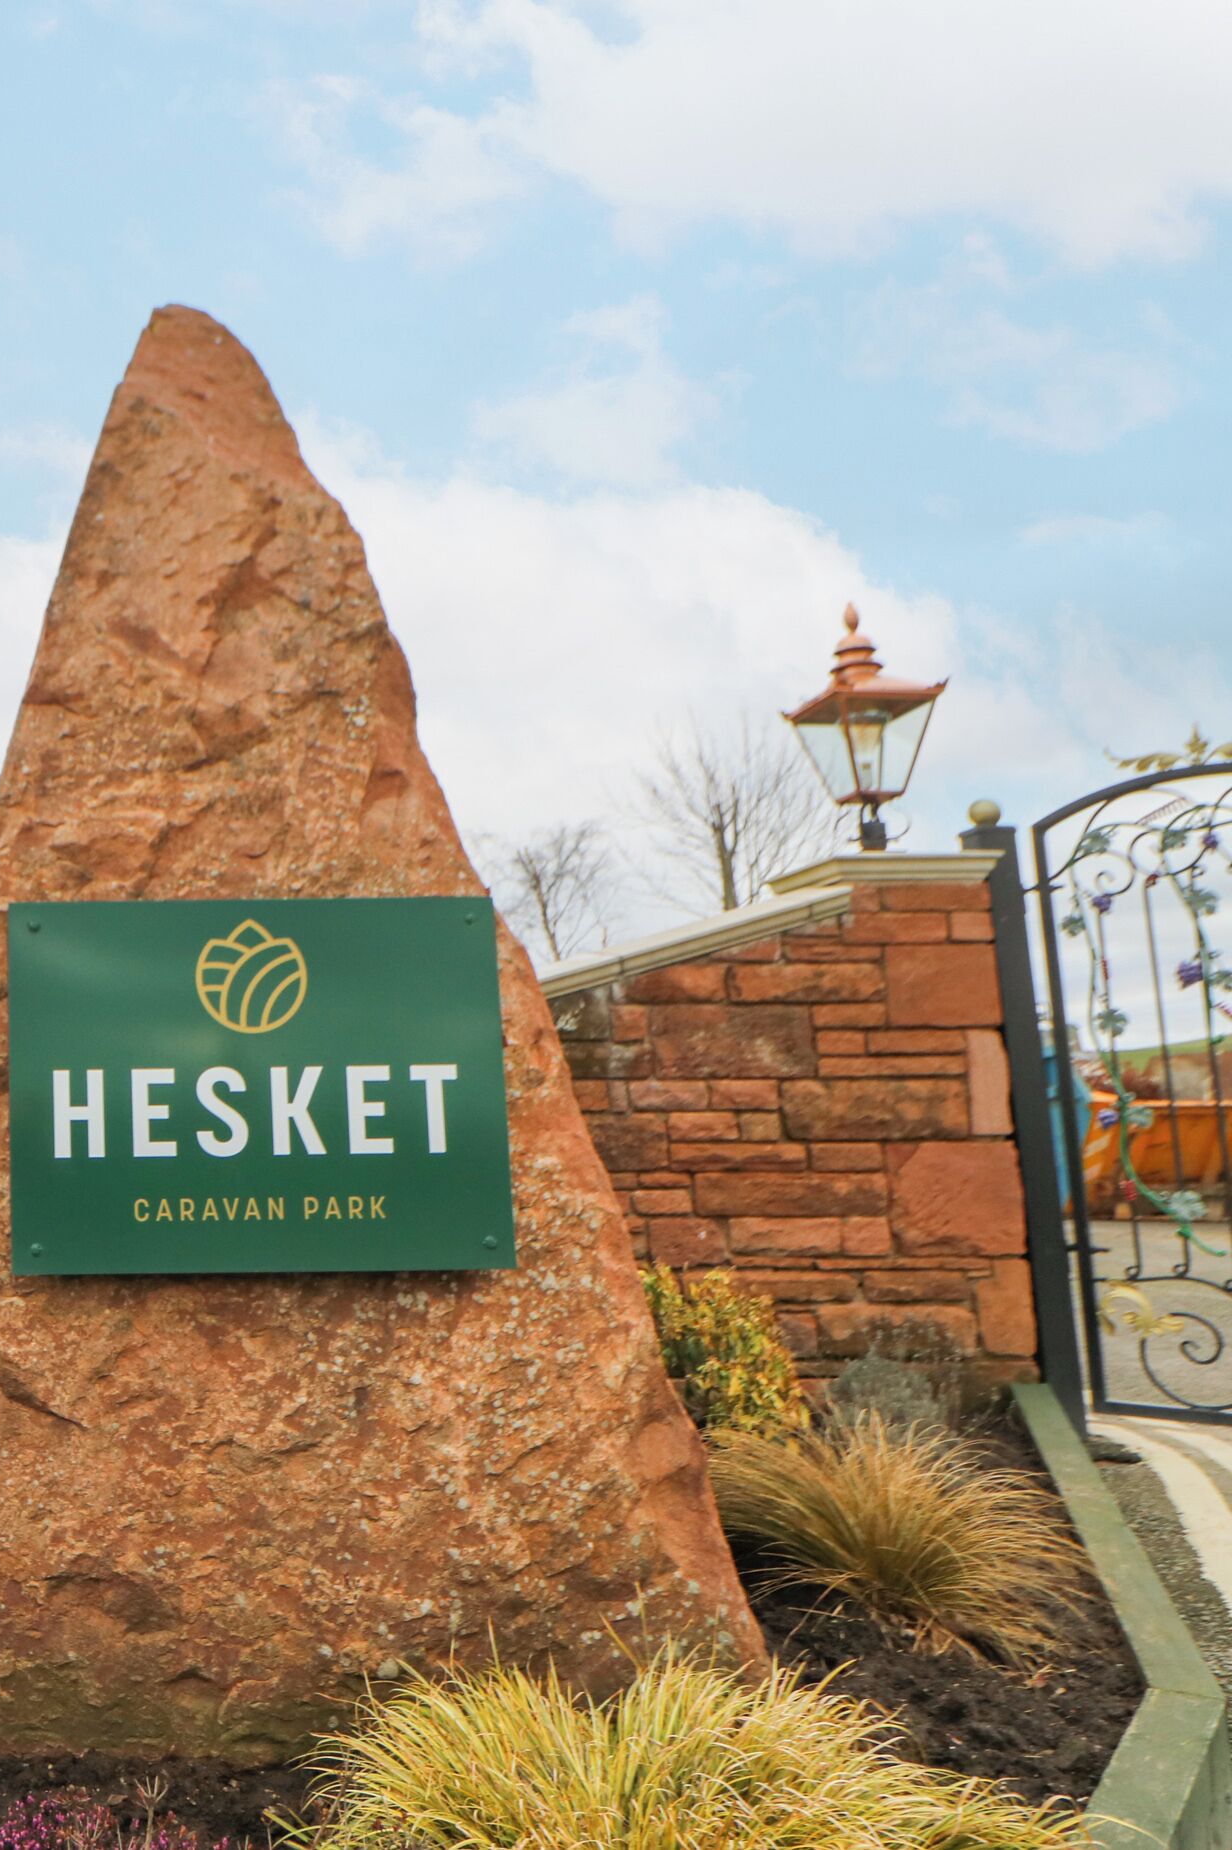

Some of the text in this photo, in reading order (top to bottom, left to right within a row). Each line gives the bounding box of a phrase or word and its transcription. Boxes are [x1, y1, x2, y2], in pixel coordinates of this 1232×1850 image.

[52, 1064, 458, 1158] HESKET
[134, 1196, 387, 1222] CARAVAN PARK
